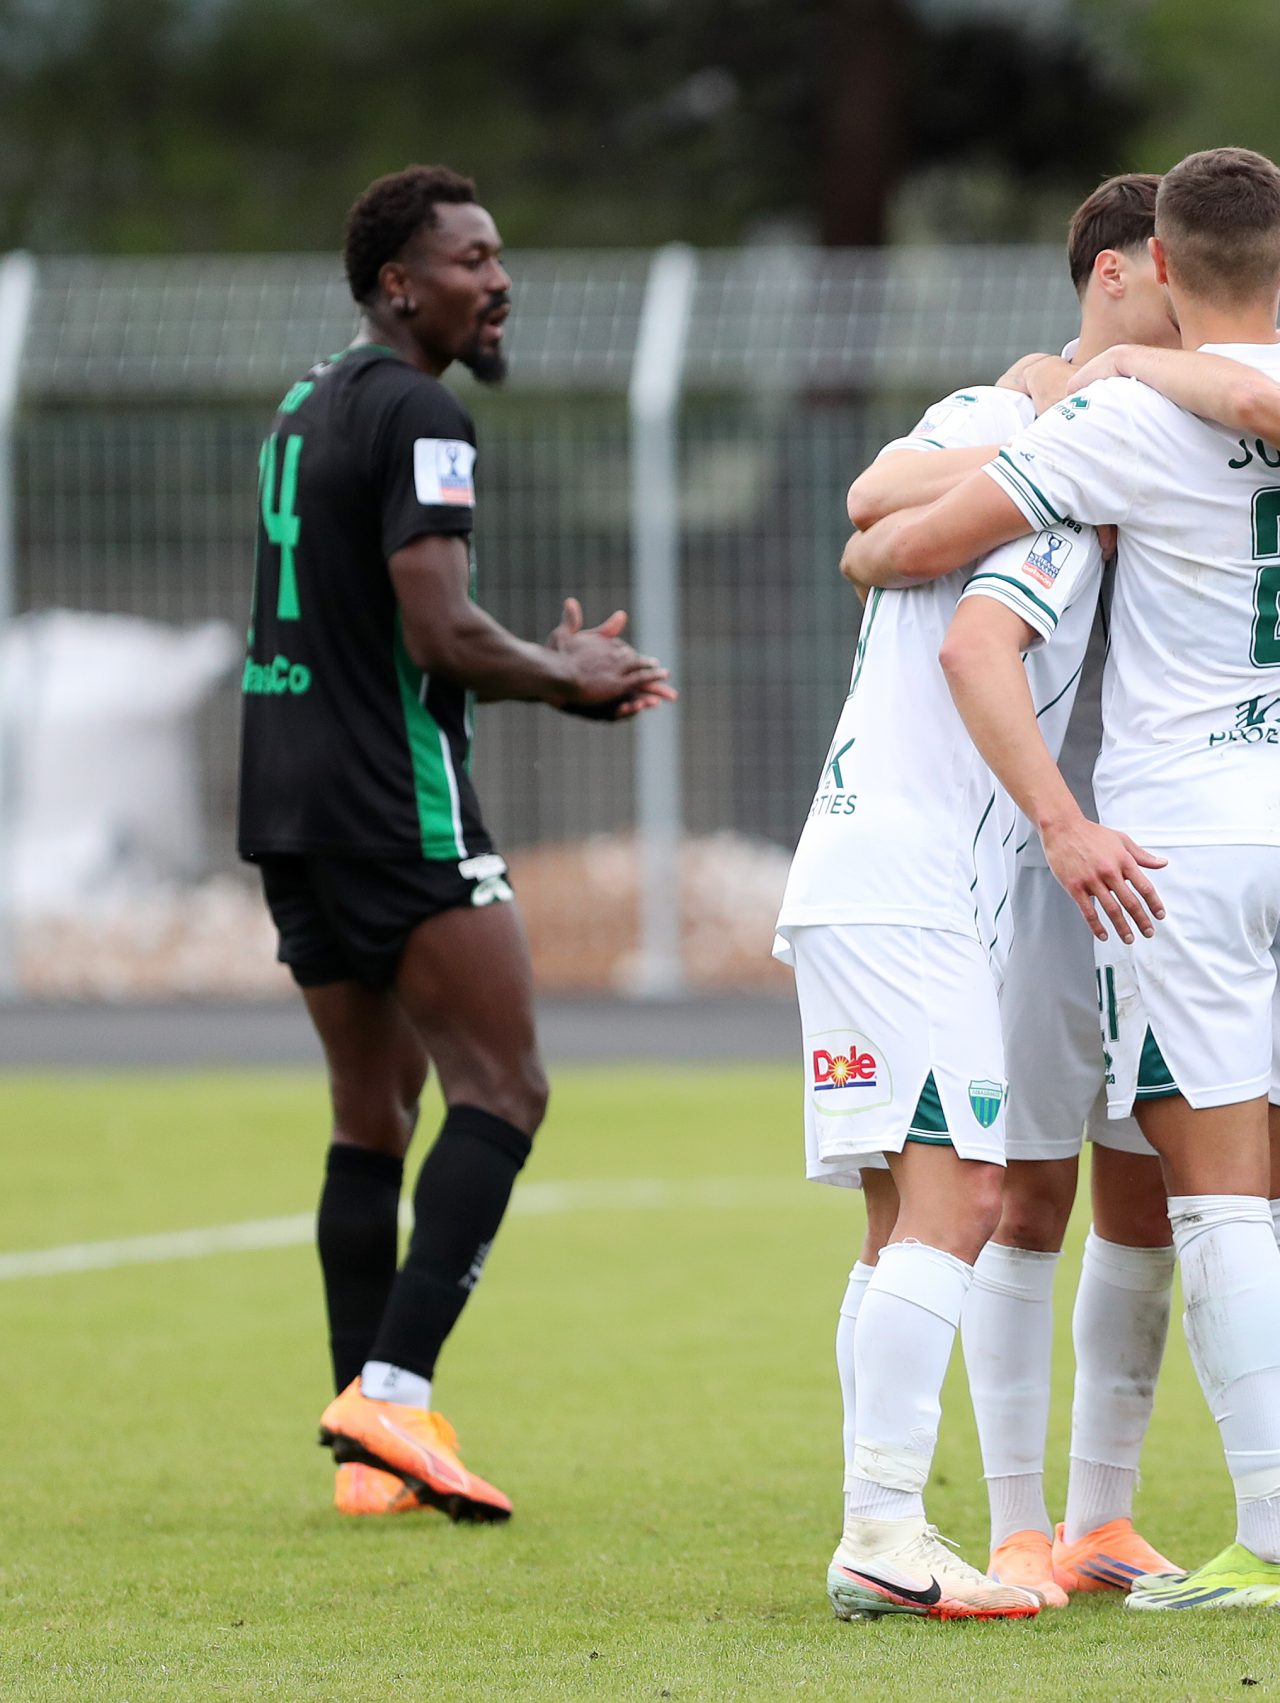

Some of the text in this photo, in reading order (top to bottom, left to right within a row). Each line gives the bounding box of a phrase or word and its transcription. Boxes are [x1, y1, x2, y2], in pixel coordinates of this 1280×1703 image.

[1061, 515, 1083, 535] rea
[823, 737, 856, 789] K
[813, 1045, 877, 1084] Dole
